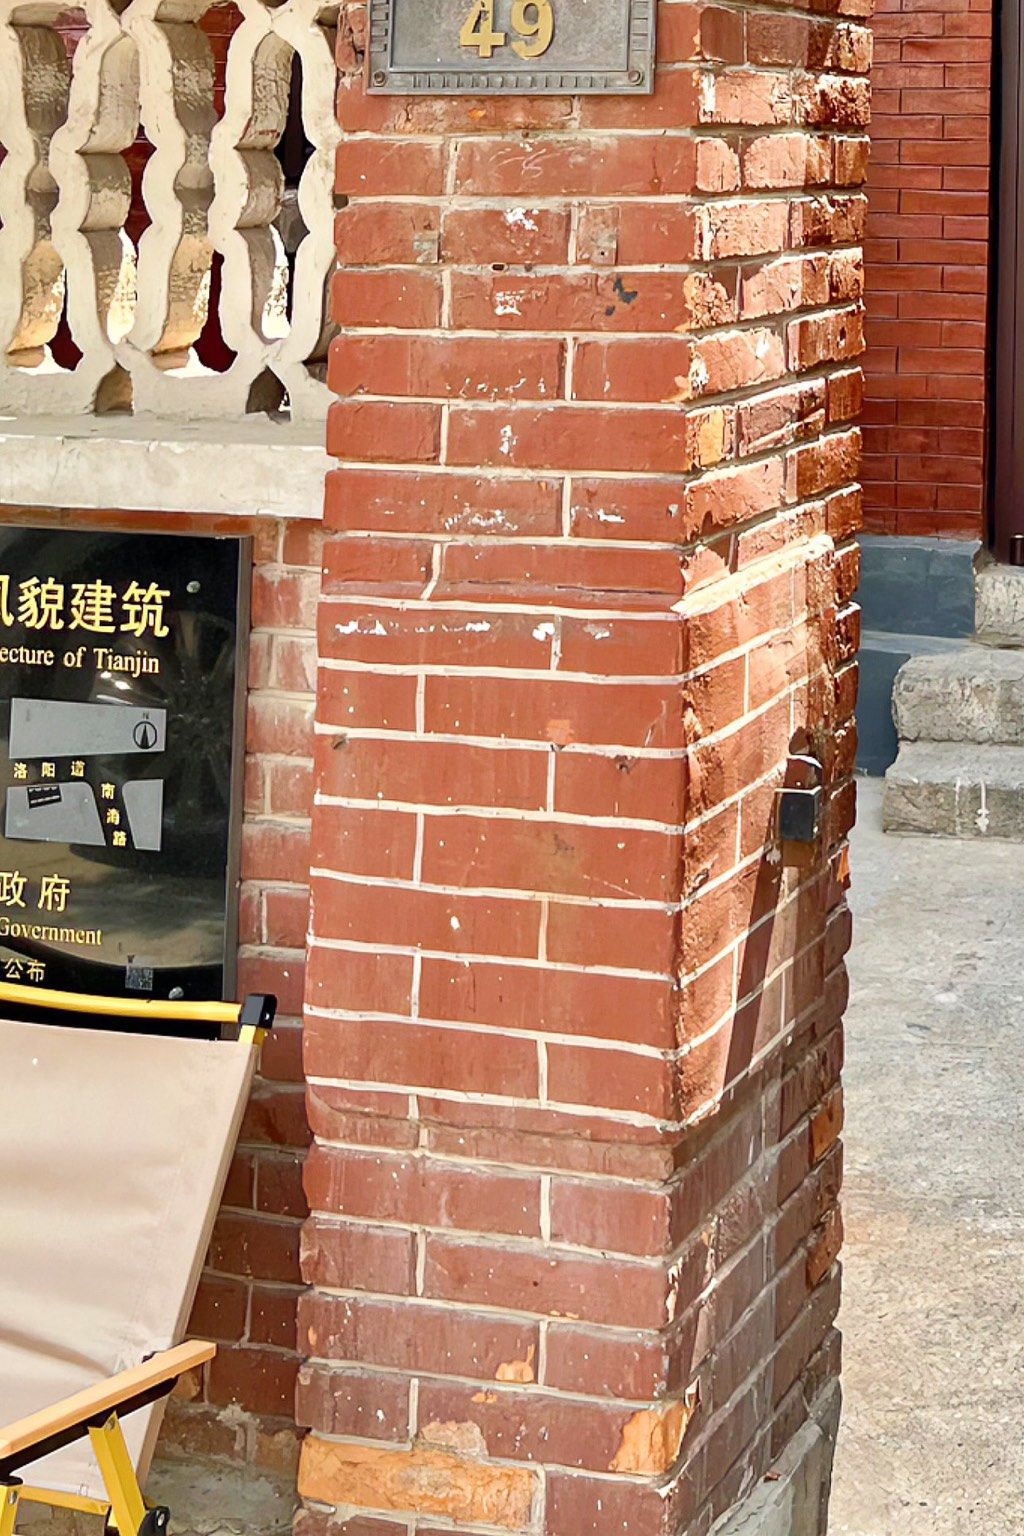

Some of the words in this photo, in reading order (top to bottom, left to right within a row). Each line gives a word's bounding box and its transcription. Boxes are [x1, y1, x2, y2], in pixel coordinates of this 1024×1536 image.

[63, 646, 87, 668] of
[93, 647, 160, 678] Tianjin
[13, 760, 86, 779] 洛阳道
[0, 870, 71, 912] 政府
[0, 916, 103, 946] Government
[4, 957, 46, 983] 公布
